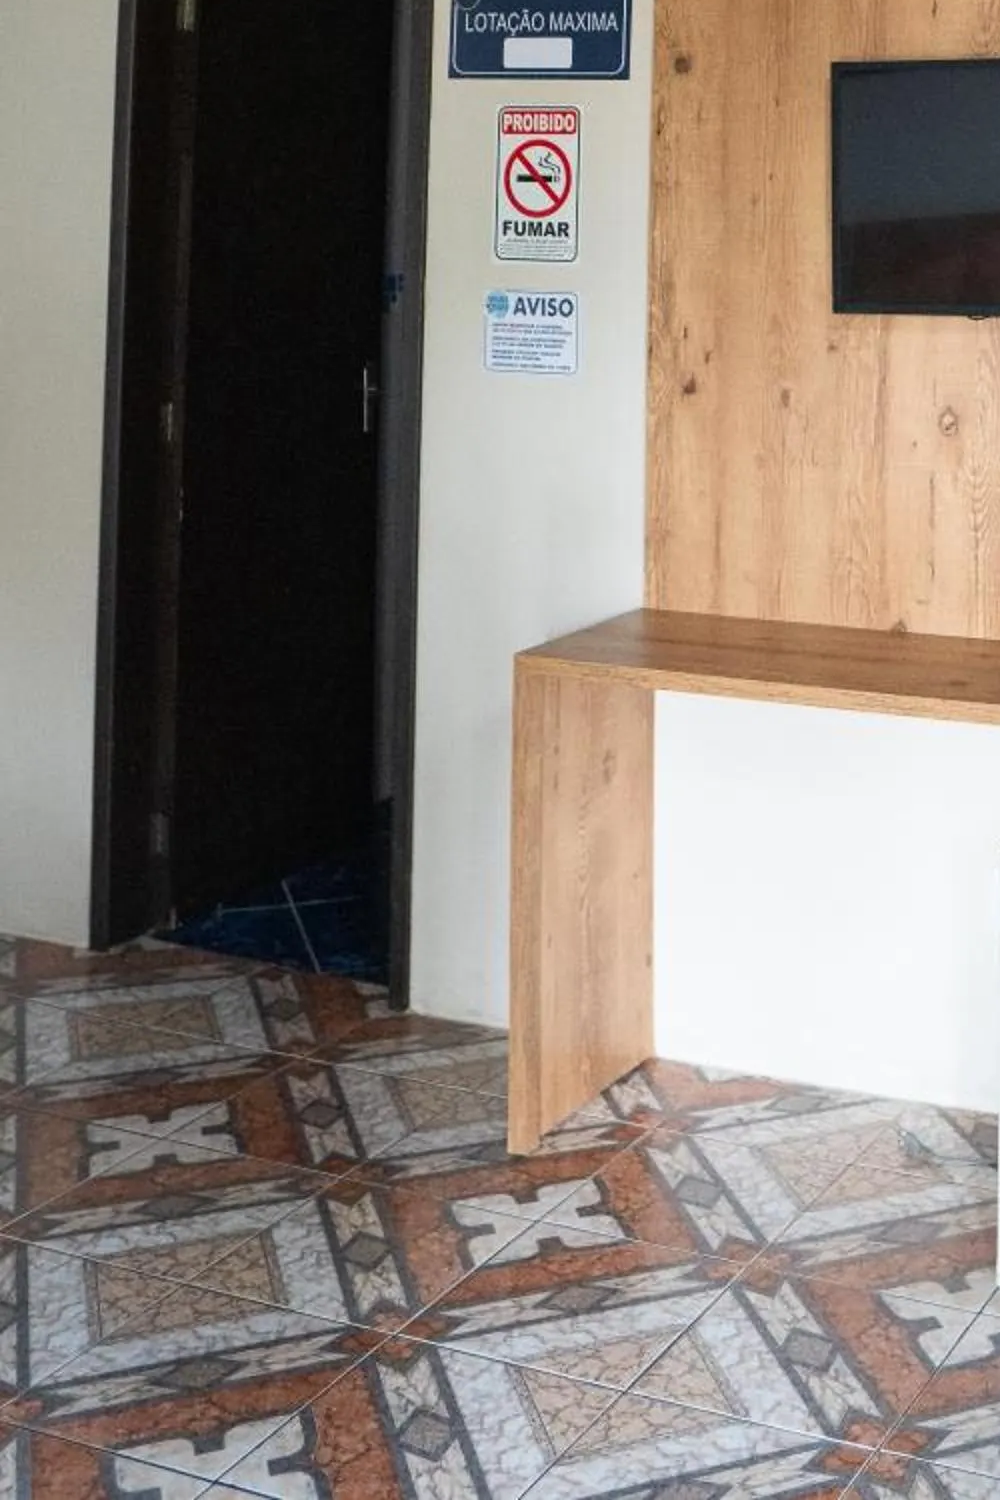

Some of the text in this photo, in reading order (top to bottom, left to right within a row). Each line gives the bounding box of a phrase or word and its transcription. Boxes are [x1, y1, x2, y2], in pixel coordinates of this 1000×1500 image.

[465, 9, 619, 36] LOTAÇÃO MAXIMA
[503, 113, 575, 132] PROIBIDO
[502, 220, 570, 238] FUMAR
[513, 296, 574, 318] AVISO
